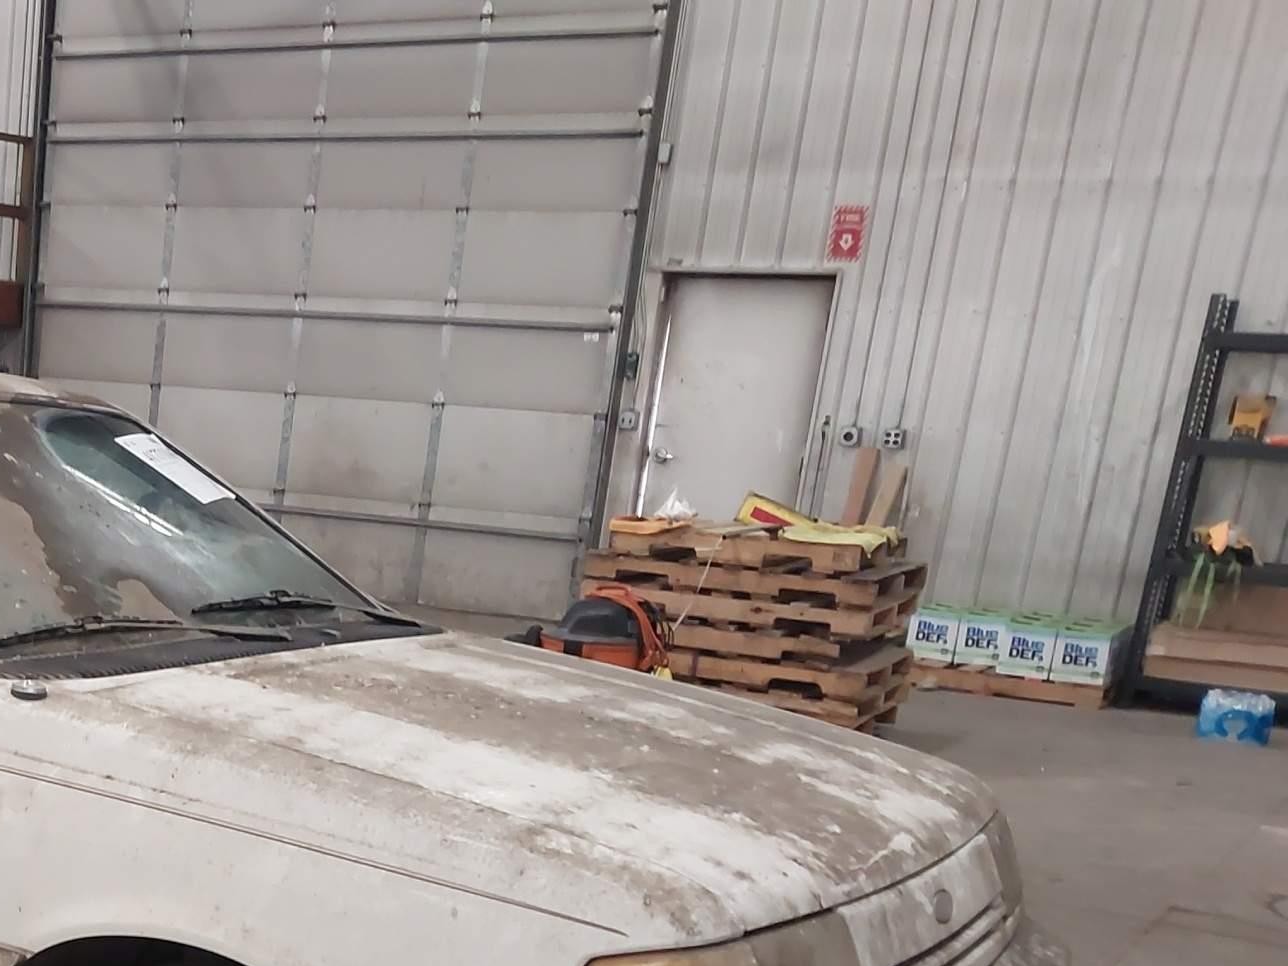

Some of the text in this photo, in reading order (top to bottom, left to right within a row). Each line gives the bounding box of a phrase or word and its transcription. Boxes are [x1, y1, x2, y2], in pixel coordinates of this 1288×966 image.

[917, 620, 949, 634] Blue
[967, 627, 999, 640] Blue
[915, 630, 948, 644] DEF
[965, 637, 999, 650] DEF
[1012, 636, 1045, 650] Blue
[1008, 647, 1044, 662] DEF
[1064, 642, 1099, 657] Blue
[1062, 654, 1098, 668] DEF
